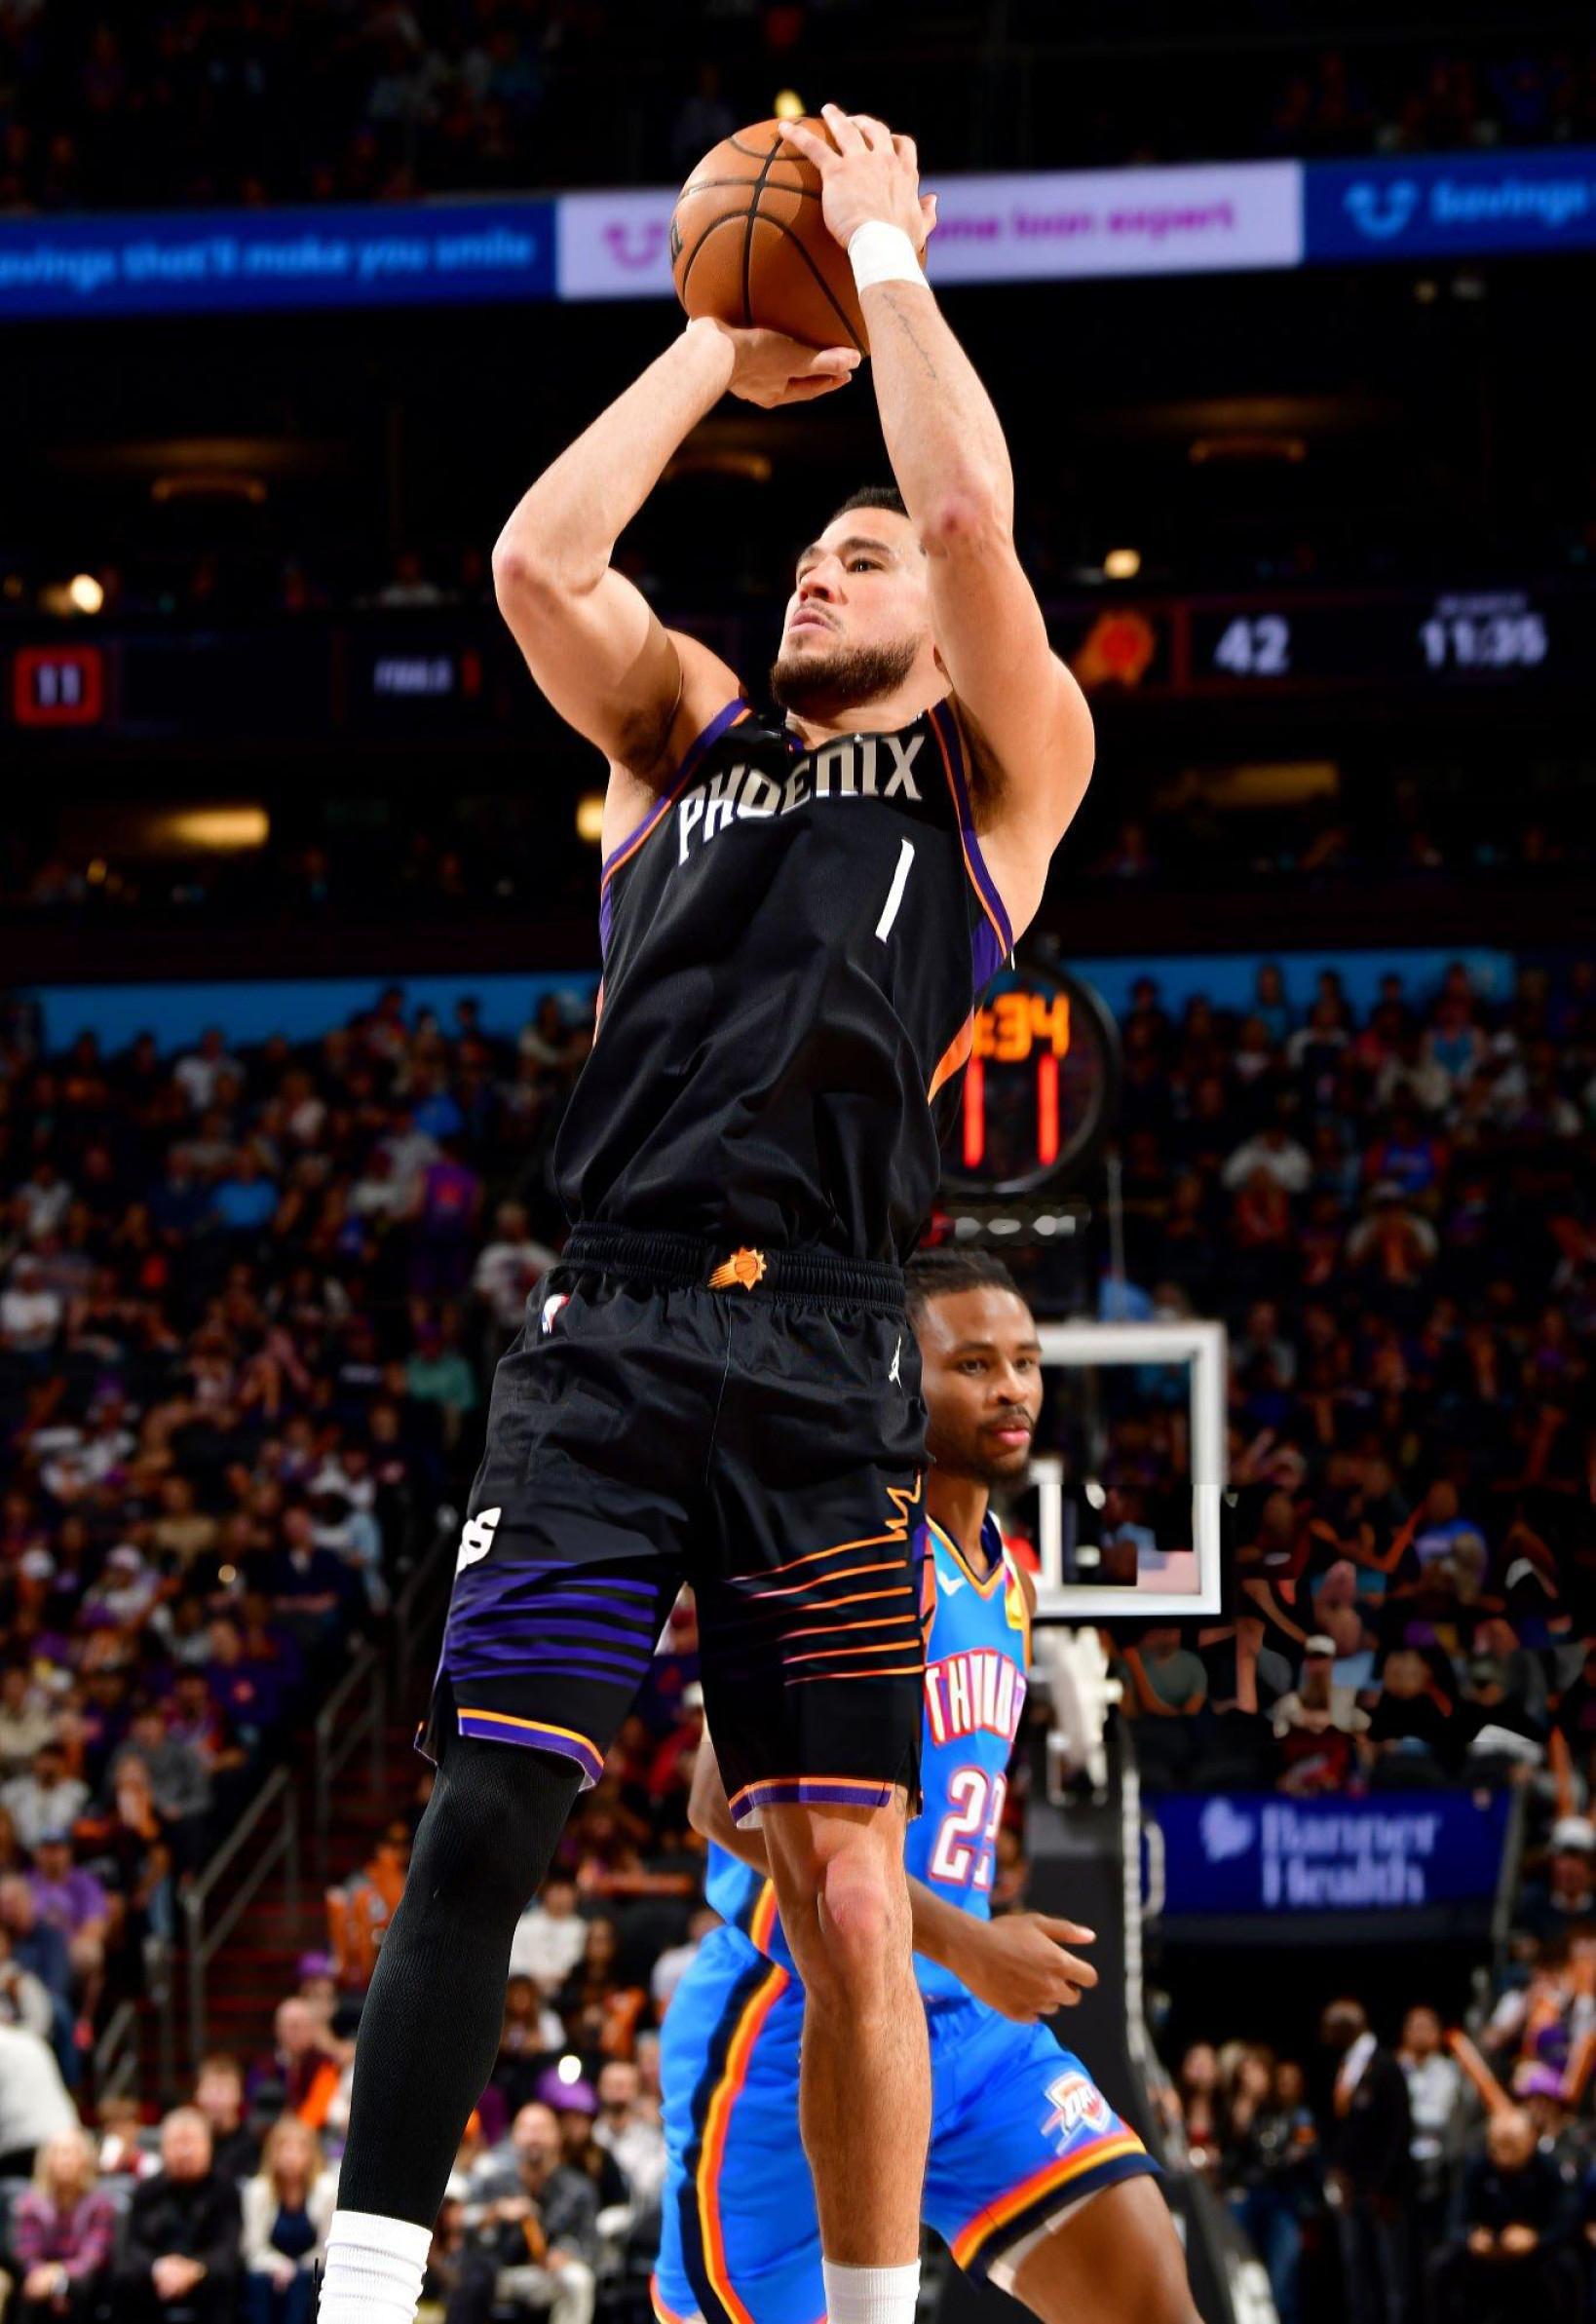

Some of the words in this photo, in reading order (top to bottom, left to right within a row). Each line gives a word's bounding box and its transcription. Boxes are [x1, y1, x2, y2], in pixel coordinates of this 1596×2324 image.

[1109, 202, 1235, 244] expert
[246, 236, 349, 276] make
[358, 238, 427, 283] you
[437, 228, 533, 270] smile
[1214, 615, 1290, 674] 42
[678, 736, 926, 865] PHOENIX
[875, 836, 915, 943] 1
[964, 1053, 1059, 1168] 11
[1263, 1804, 1439, 1853] Banner
[1263, 1857, 1425, 1905] Health
